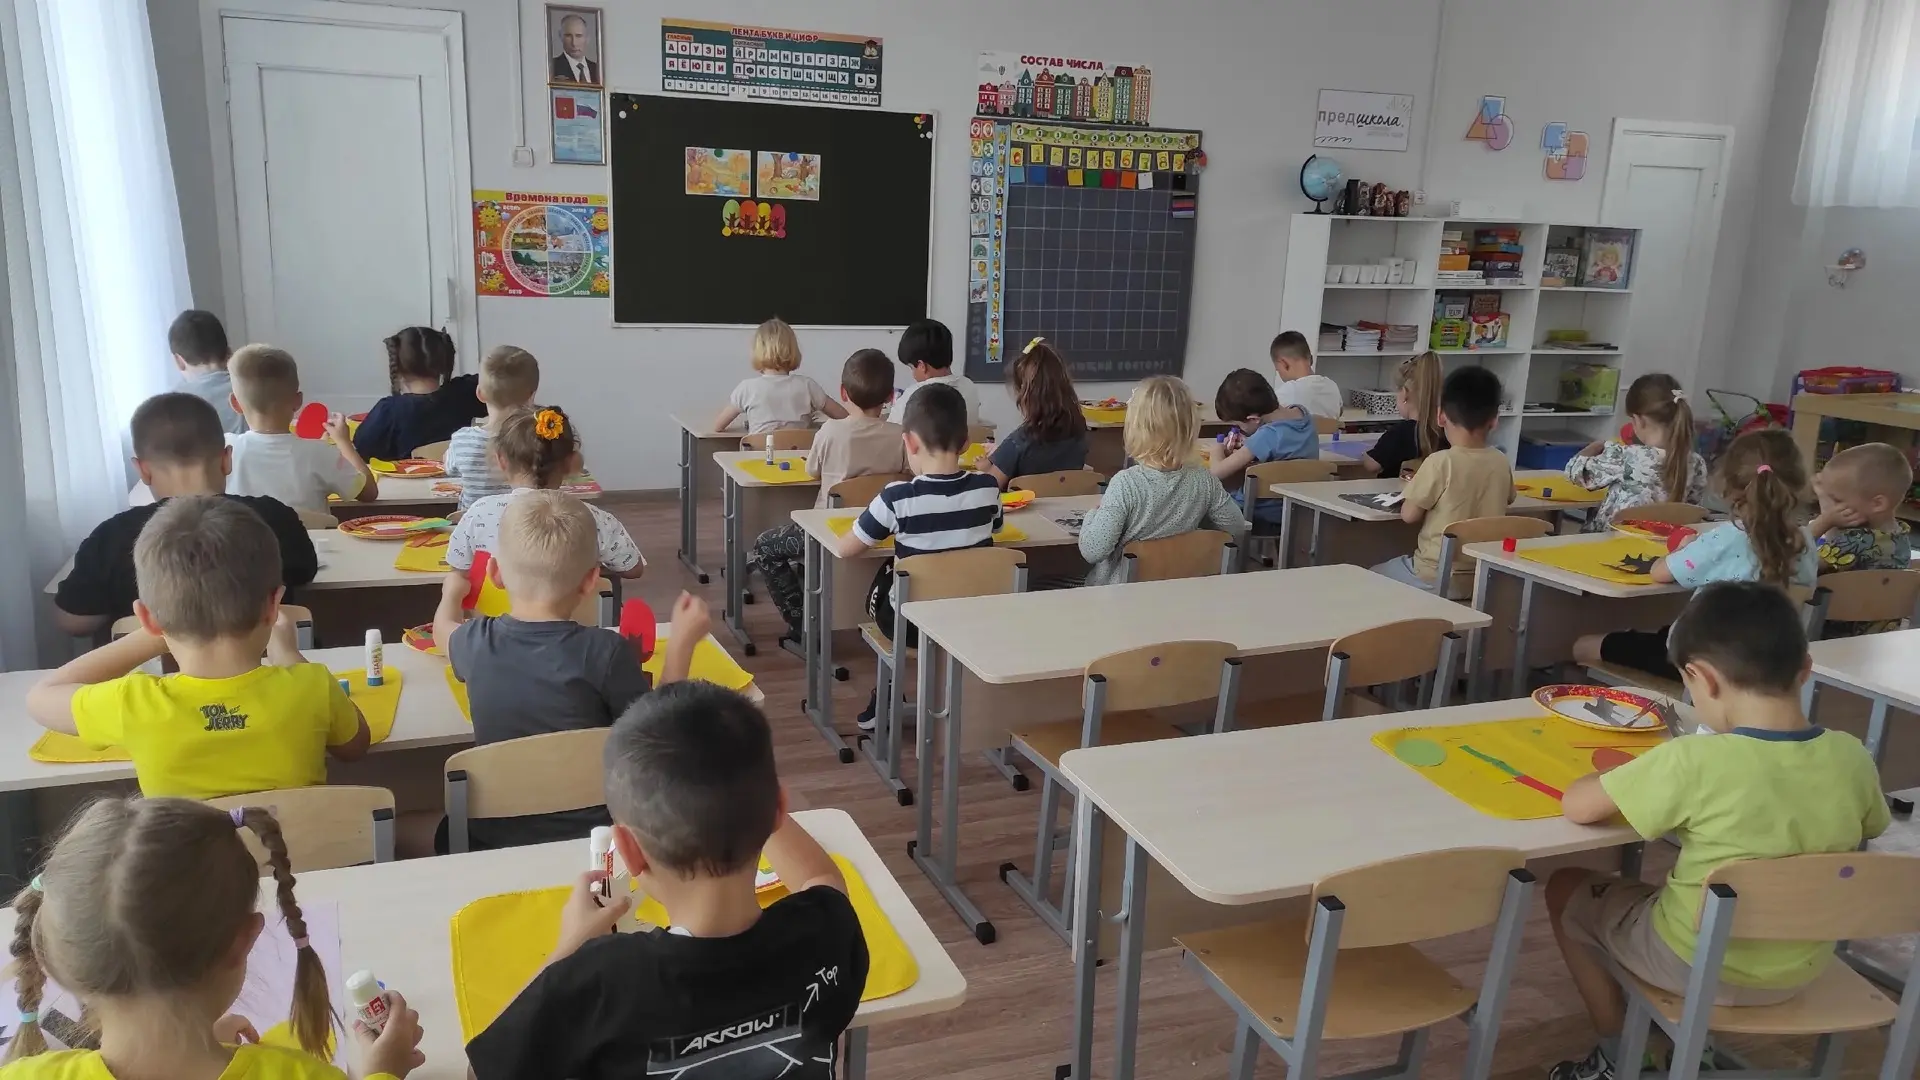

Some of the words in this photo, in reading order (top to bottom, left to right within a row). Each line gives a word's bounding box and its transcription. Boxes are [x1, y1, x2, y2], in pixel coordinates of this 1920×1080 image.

[732, 28, 760, 37] ЛЕНТА
[761, 30, 784, 39] БУКВ
[793, 32, 819, 42] ЦИФР
[736, 48, 741, 56] Й
[830, 57, 835, 65] З
[841, 58, 847, 66] Д
[851, 58, 860, 66] Ж
[1020, 55, 1063, 67] СОСТАВ
[1066, 59, 1104, 71] ЧИСЛА
[681, 60, 686, 69] Ё
[692, 62, 701, 70] Ю
[706, 63, 711, 71] Е
[735, 66, 741, 74] П
[746, 66, 754, 75] Ф
[794, 70, 802, 78] Ш
[806, 72, 812, 80] Ц
[828, 73, 836, 82] Щ
[841, 74, 847, 82] Х
[505, 192, 558, 203] Времена
[561, 196, 589, 204] года
[204, 714, 248, 731] JERRY
[816, 965, 838, 986] Top
